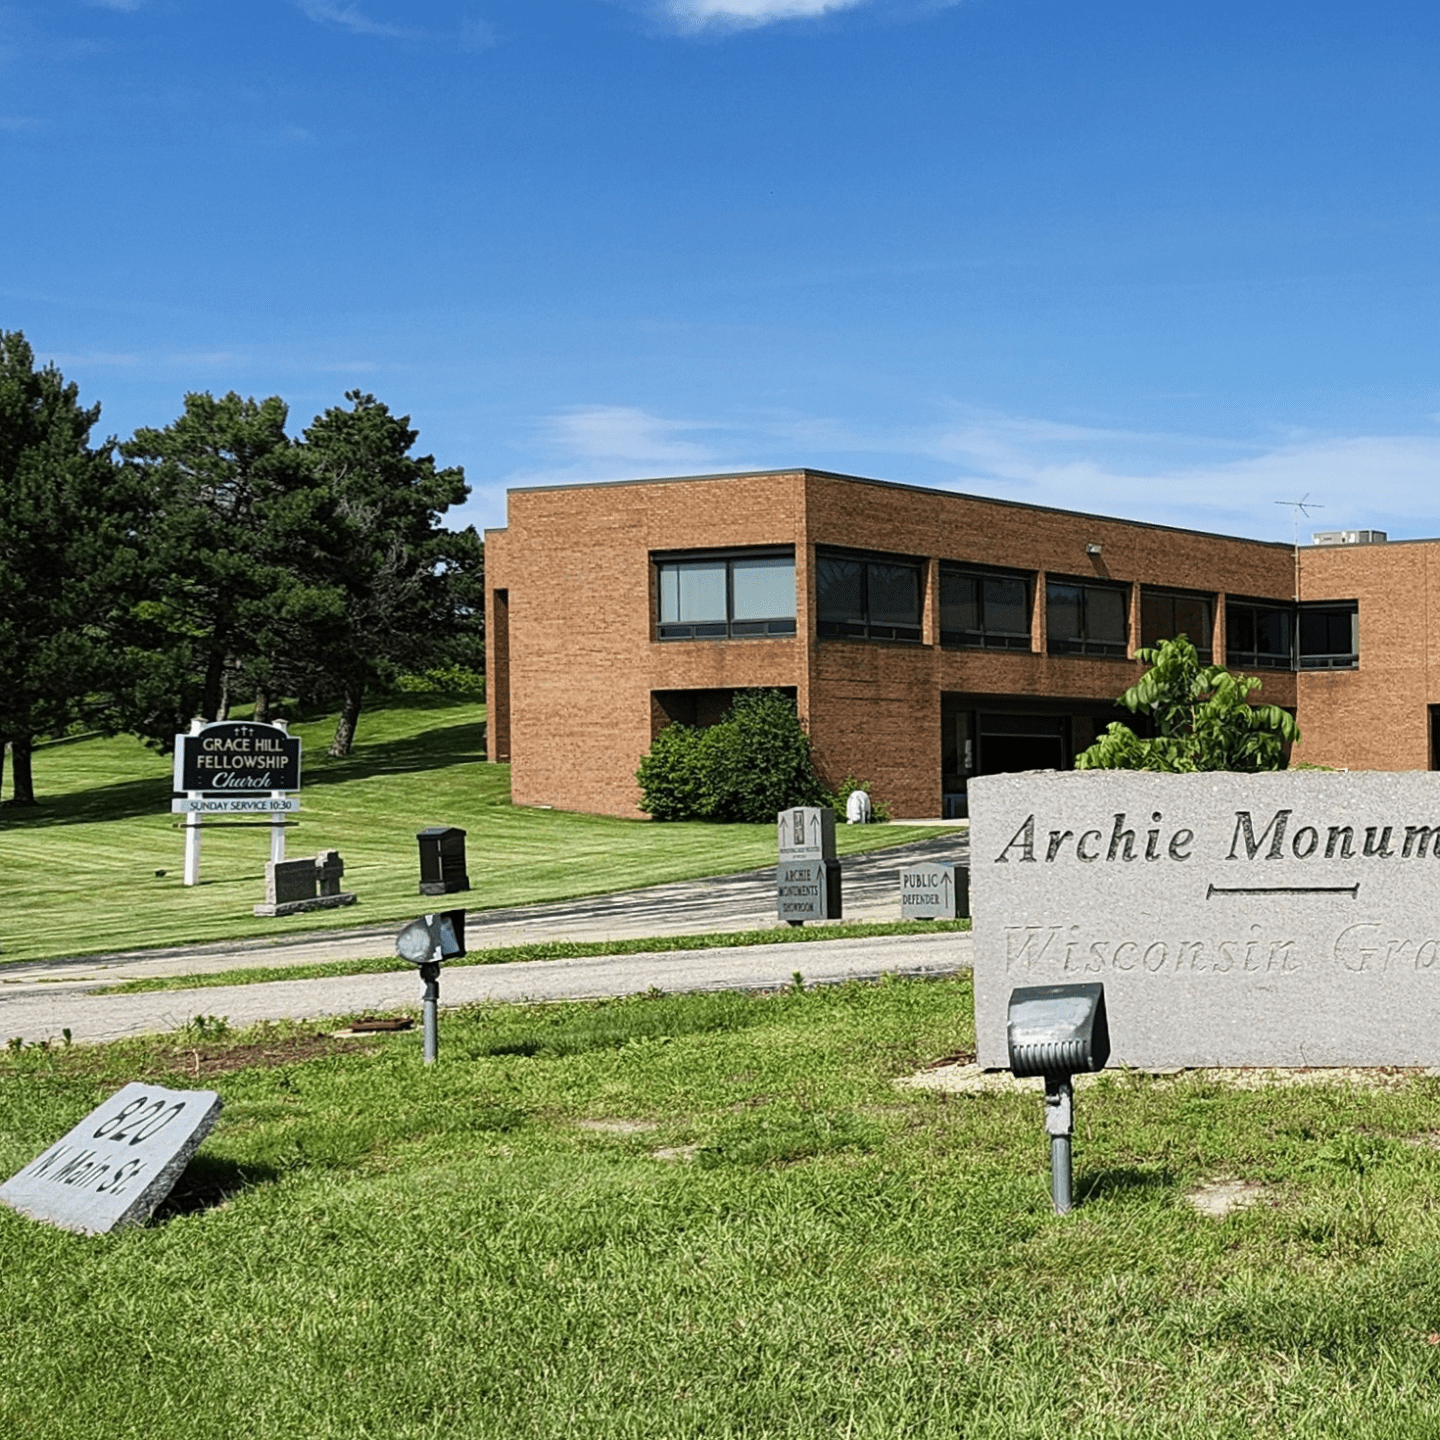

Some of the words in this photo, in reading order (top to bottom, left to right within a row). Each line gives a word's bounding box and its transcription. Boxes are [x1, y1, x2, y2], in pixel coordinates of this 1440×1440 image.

[202, 738, 250, 752] GRACE
[255, 738, 283, 752] HILL
[197, 755, 289, 769] FELLOWSHIP
[212, 771, 272, 788] Church
[190, 801, 228, 811] SUNDAY
[230, 801, 267, 810] SERVICE
[270, 801, 292, 810] 10:30
[994, 811, 1195, 863] Archie
[785, 869, 811, 882] ARCHIE
[903, 873, 939, 889] PUBLIC
[902, 893, 941, 906] DEFENDER
[1003, 924, 1301, 973] Wisconsin
[92, 1096, 187, 1146] 820
[47, 1149, 112, 1188] Main
[95, 1158, 148, 1196] St.
